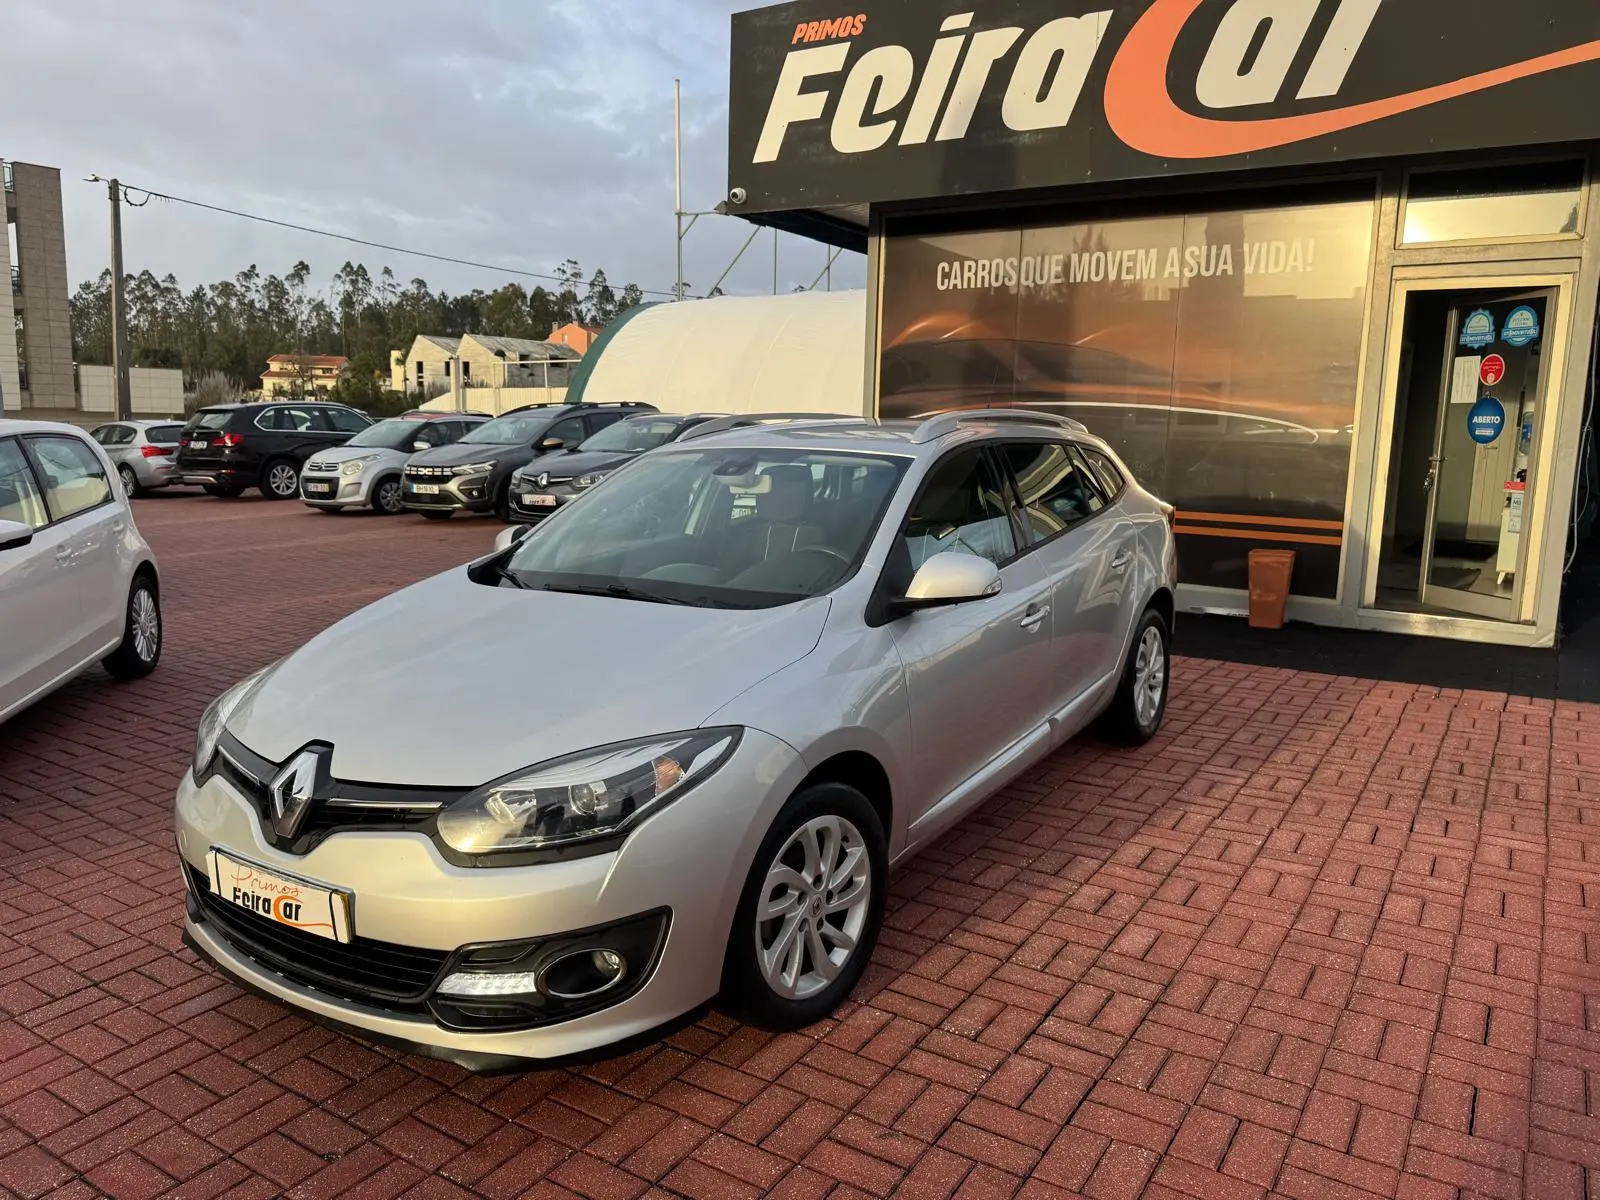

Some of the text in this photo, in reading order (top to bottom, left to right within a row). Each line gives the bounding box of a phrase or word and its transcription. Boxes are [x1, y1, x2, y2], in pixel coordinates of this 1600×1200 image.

[792, 13, 867, 44] PRIMOS
[936, 238, 1315, 290] CARROS QUE MOVEM A SUA VIDA!
[1472, 415, 1501, 424] ABERTO
[231, 865, 302, 896] Primos
[233, 886, 304, 927] FeiraCar
